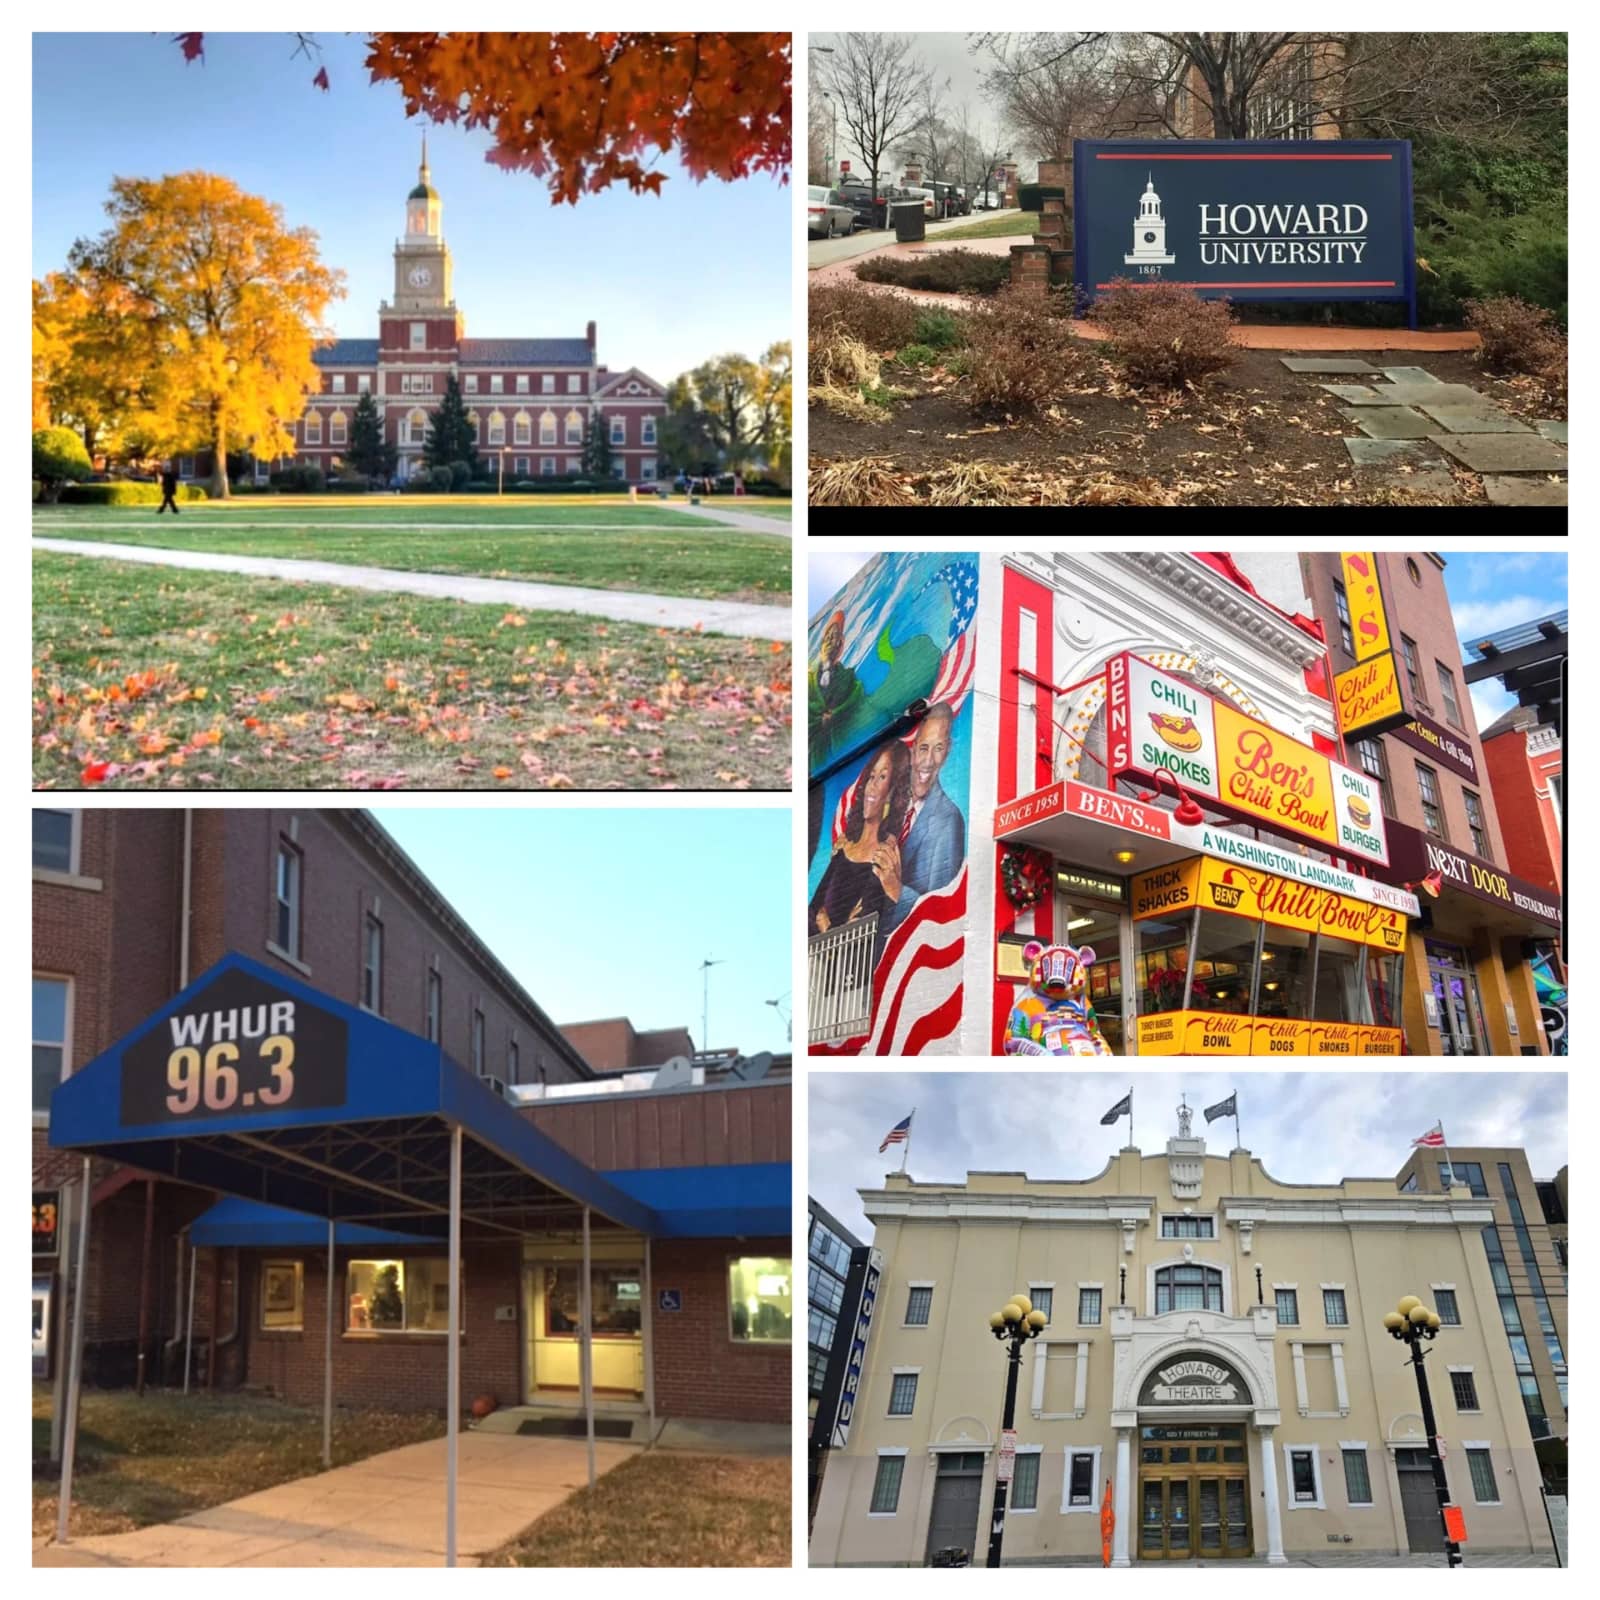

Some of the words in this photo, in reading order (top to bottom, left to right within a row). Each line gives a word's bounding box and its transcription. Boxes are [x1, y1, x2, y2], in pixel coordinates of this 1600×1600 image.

[1199, 203, 1368, 235] HOWARD
[1200, 241, 1366, 265] UNIVERSITY
[1138, 265, 1162, 275] 1867
[1340, 663, 1378, 703] Chili
[1151, 680, 1197, 715] CHILI
[1343, 673, 1394, 726] Bowl
[1142, 743, 1210, 785] SMOKES
[1235, 730, 1314, 798] Ben's
[1342, 774, 1370, 798] CHILI
[998, 803, 1032, 827] SINCE
[1035, 792, 1059, 814] 1958
[1077, 791, 1162, 833] BEN'S...
[1229, 771, 1273, 810] Chili
[1277, 792, 1329, 831] Bowl
[1343, 825, 1382, 855] BURGER
[1144, 869, 1181, 892] THICK
[1203, 832, 1213, 849] A
[1215, 835, 1297, 875] WASHINGTON
[1299, 862, 1356, 892] LANDMARK
[1372, 887, 1400, 906] SINCE
[1138, 886, 1189, 913] SHAKES
[1214, 886, 1239, 906] BEN'S
[1254, 873, 1320, 920] Chili
[1320, 892, 1382, 935] Bowl
[1470, 863, 1511, 902] DOOR
[1512, 890, 1557, 920] RESTAURANT
[170, 1000, 295, 1047] WHUR
[1204, 1016, 1239, 1034] Chili
[1269, 1021, 1300, 1038] Chili
[1324, 1026, 1349, 1040] Chili
[1370, 1030, 1391, 1042] Chili
[1203, 1035, 1232, 1047] BOWL
[1270, 1040, 1295, 1052] DOGS
[1319, 1042, 1350, 1053] SMOKES
[1364, 1043, 1395, 1054] BURGERS
[166, 1035, 295, 1114] 96.3
[840, 1273, 877, 1422] HOWARD
[1165, 1362, 1224, 1382] HOWARD
[1167, 1386, 1222, 1399] THEATRE
